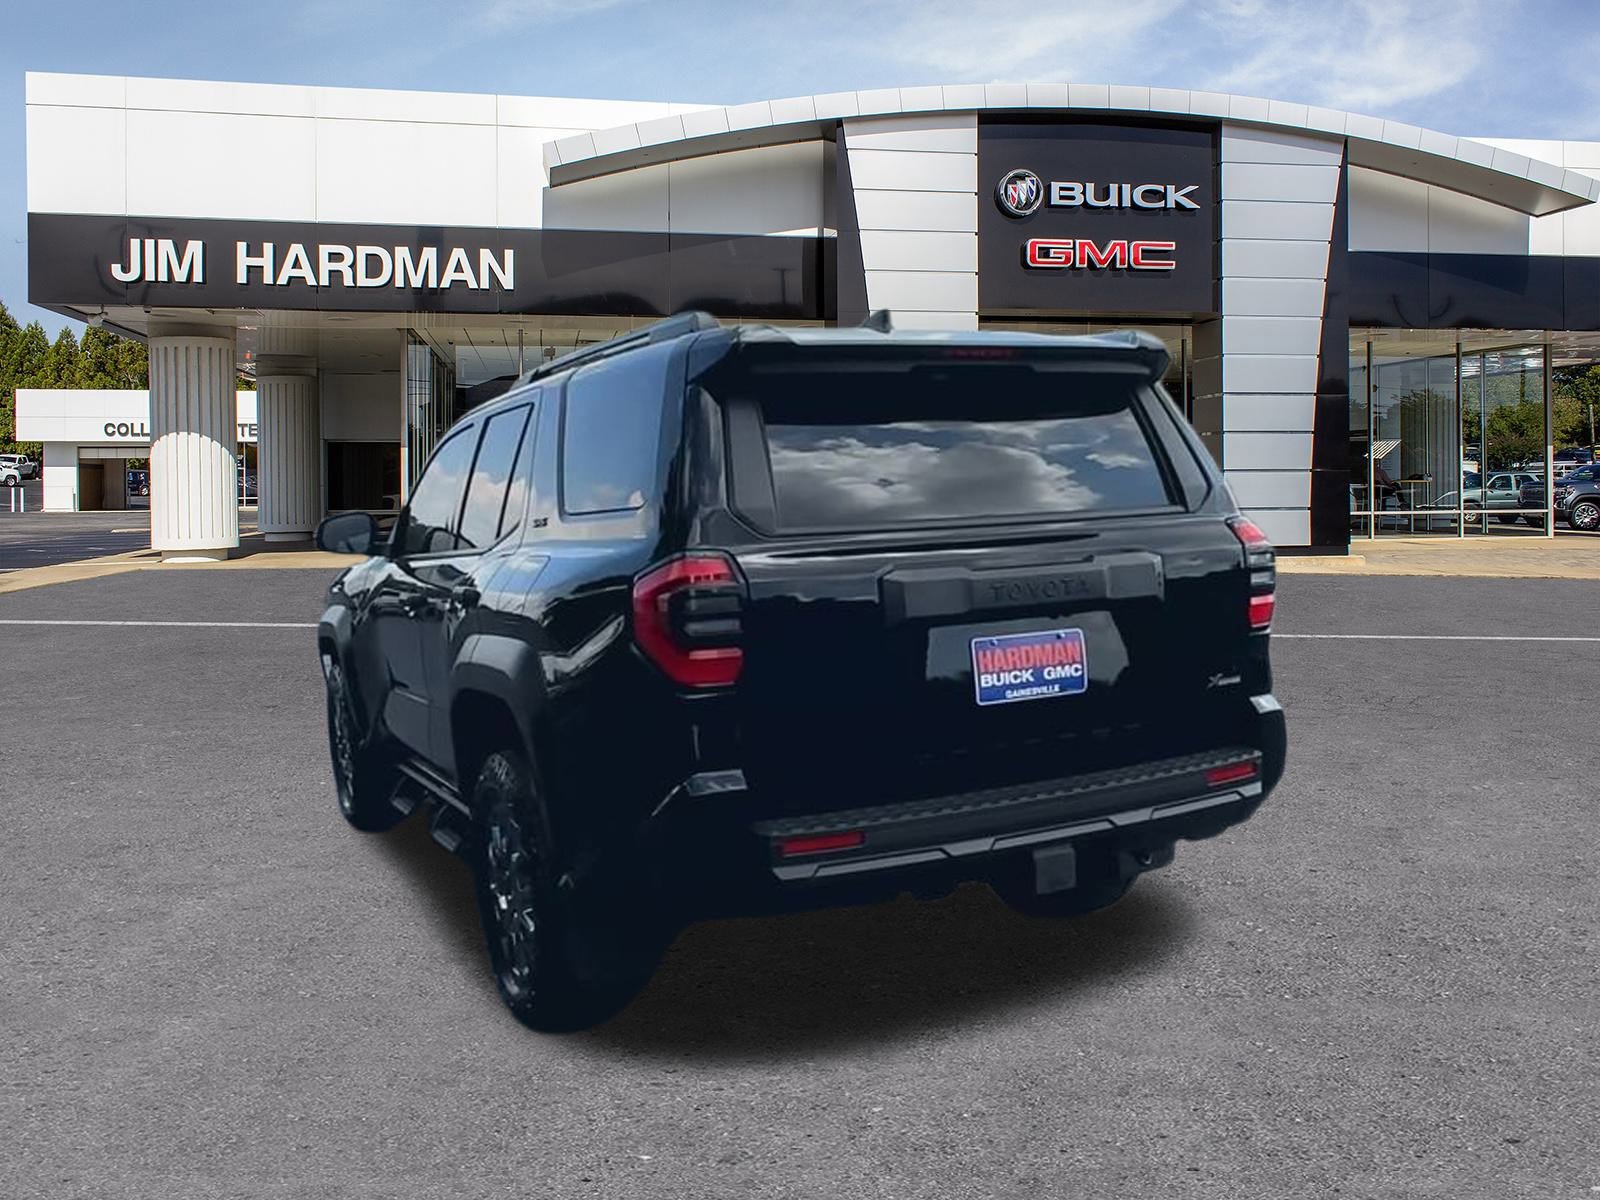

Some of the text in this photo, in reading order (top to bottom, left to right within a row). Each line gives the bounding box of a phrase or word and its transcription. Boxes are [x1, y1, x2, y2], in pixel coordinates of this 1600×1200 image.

[1049, 181, 1200, 210] BUICK
[111, 237, 515, 290] JIM HARDMAN
[1026, 238, 1176, 270] GMC
[978, 642, 1081, 672] HARDMAN
[980, 664, 1082, 688] BUICK GMC
